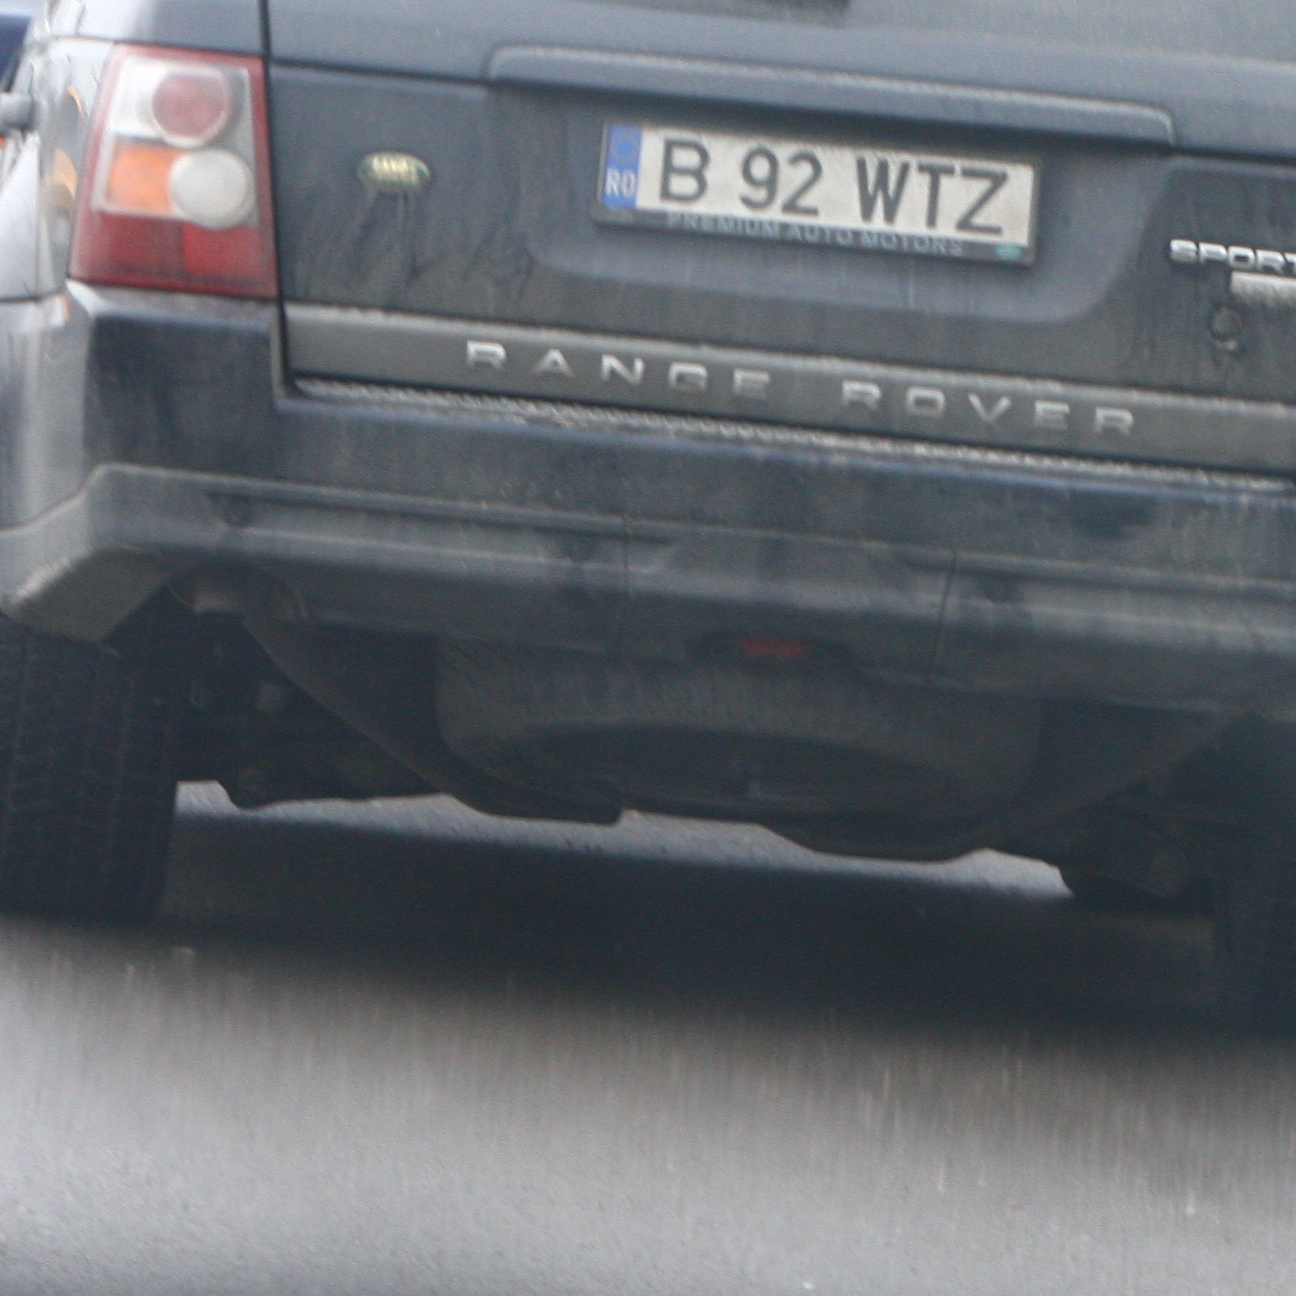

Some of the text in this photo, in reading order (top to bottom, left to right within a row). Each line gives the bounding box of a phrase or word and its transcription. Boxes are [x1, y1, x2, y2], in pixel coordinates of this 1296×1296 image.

[604, 168, 637, 197] RO
[659, 138, 1010, 236] B 92 WTZ
[465, 339, 1136, 436] RANGE ROVER
